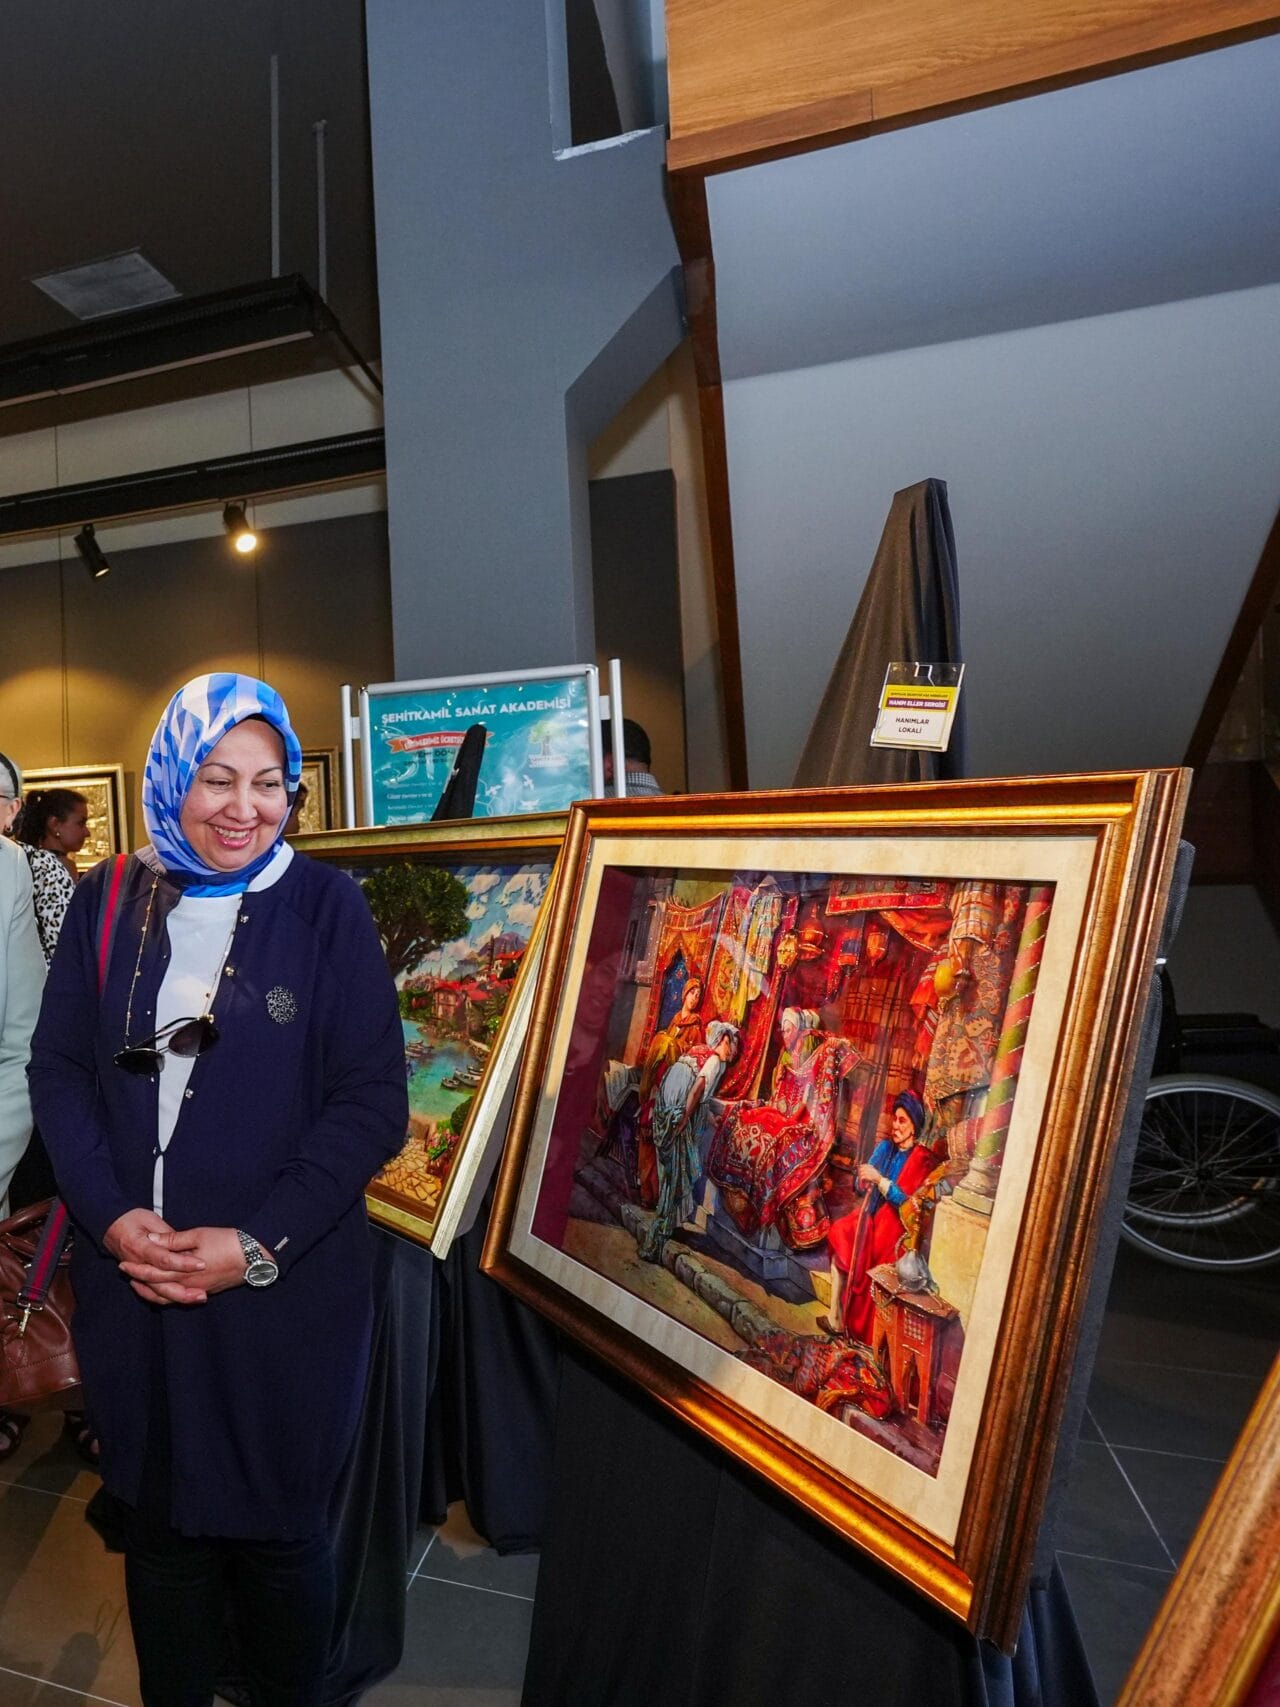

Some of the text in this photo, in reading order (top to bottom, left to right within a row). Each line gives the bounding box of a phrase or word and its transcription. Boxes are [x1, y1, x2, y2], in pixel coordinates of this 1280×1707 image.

[381, 697, 571, 725] ŞEHİTKAMİL SANAT AKADEMİSİ
[895, 717, 930, 725] HANIMLAR
